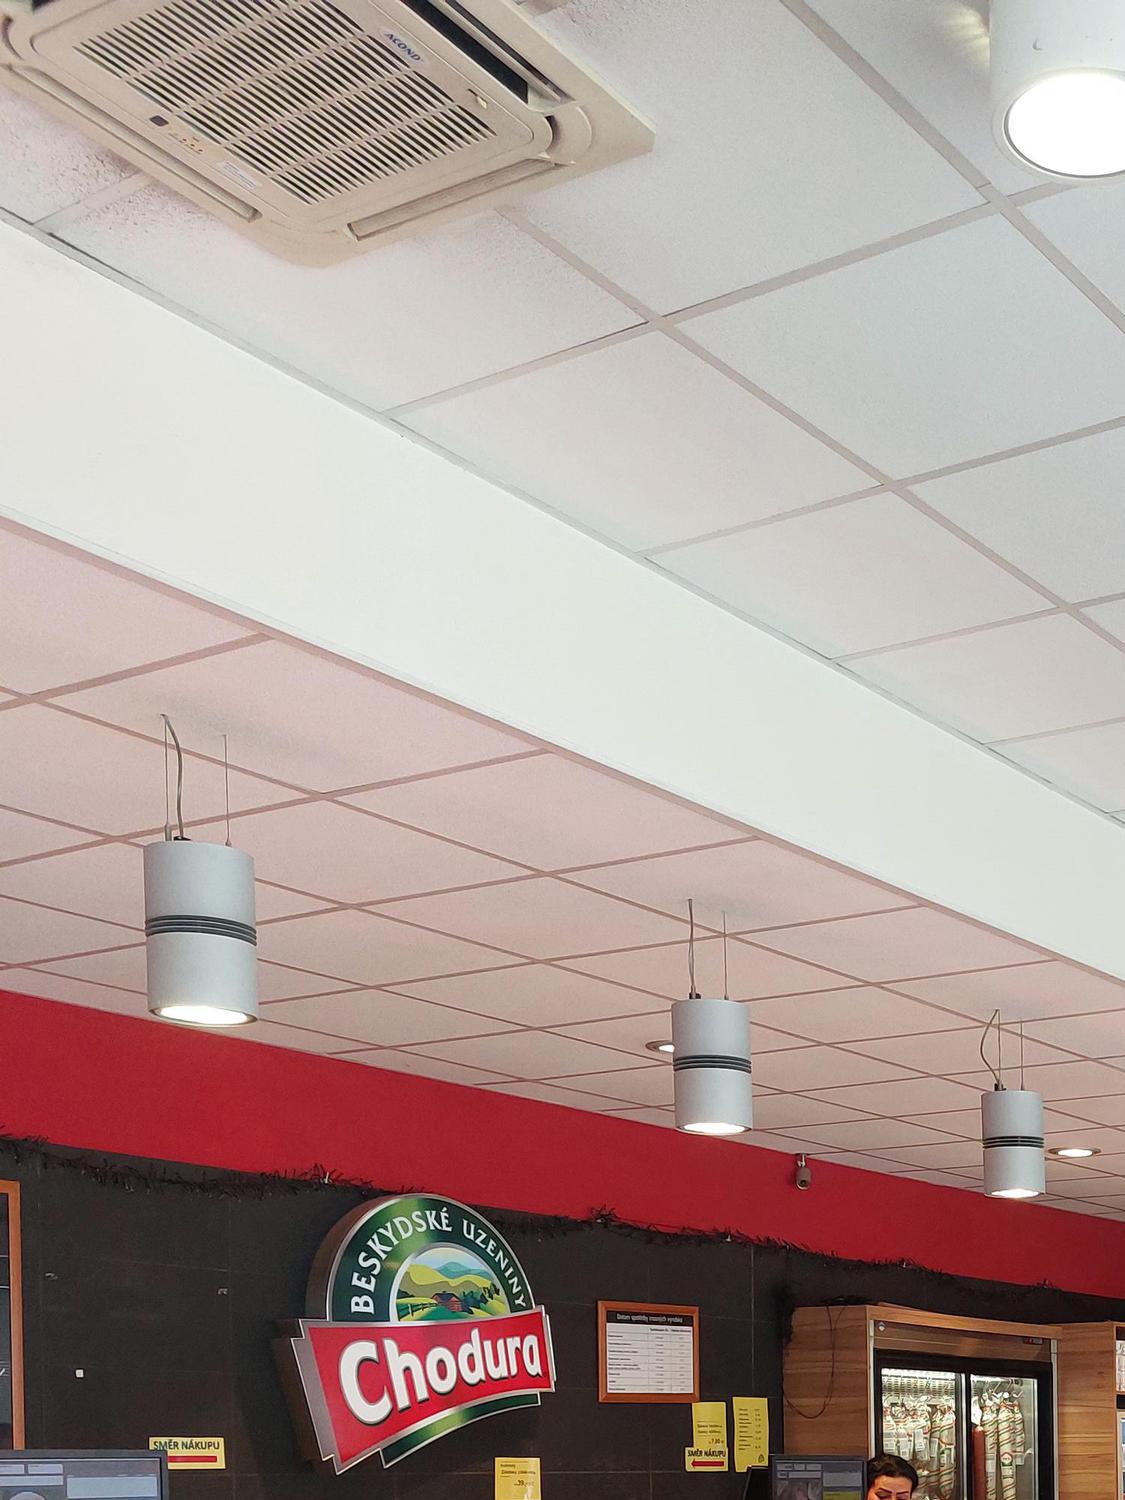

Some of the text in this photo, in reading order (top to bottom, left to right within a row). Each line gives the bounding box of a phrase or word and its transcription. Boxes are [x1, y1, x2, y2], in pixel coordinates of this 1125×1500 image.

[384, 34, 421, 61] ACOND
[350, 1207, 527, 1315] BESKYDSKÉ UZENINY
[338, 1327, 543, 1424] Chodura
[153, 1437, 221, 1451] SMĚR NÁKUPU
[687, 1447, 727, 1458] SMĚR NÁKUPU
